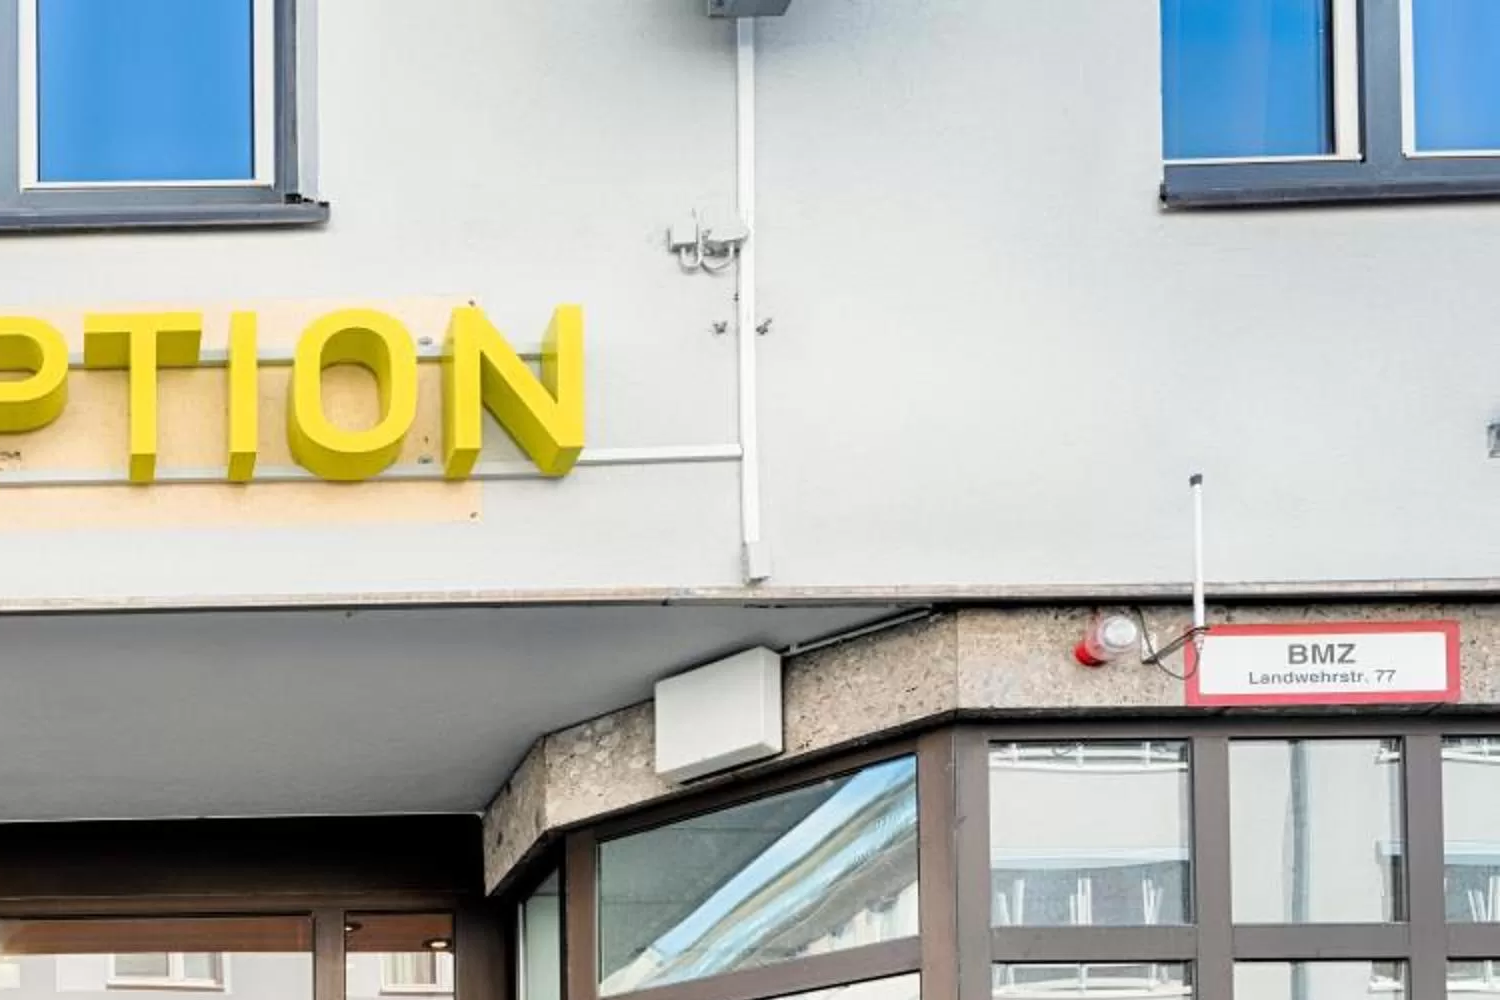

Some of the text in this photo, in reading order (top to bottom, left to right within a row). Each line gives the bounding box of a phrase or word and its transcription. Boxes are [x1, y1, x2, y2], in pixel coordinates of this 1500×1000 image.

[1287, 643, 1357, 665] BMZ
[1248, 669, 1397, 685] Landwehrstr. 77
